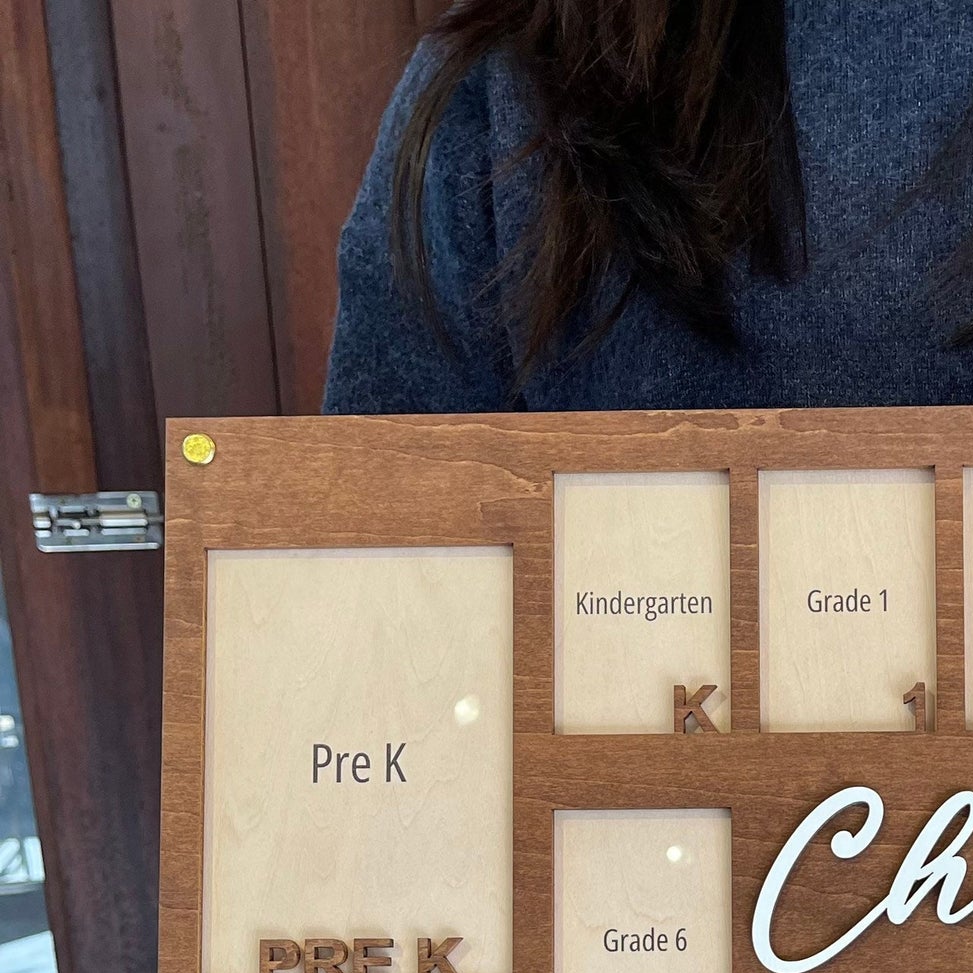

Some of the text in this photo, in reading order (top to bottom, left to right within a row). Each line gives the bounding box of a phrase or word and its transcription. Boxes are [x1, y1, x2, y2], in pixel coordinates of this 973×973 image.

[577, 591, 712, 621] Kindergarten
[808, 588, 886, 612] Grade 1
[673, 684, 719, 733] K
[902, 681, 931, 731] 1
[313, 743, 406, 783] Pre K
[604, 927, 687, 952] Grade 6
